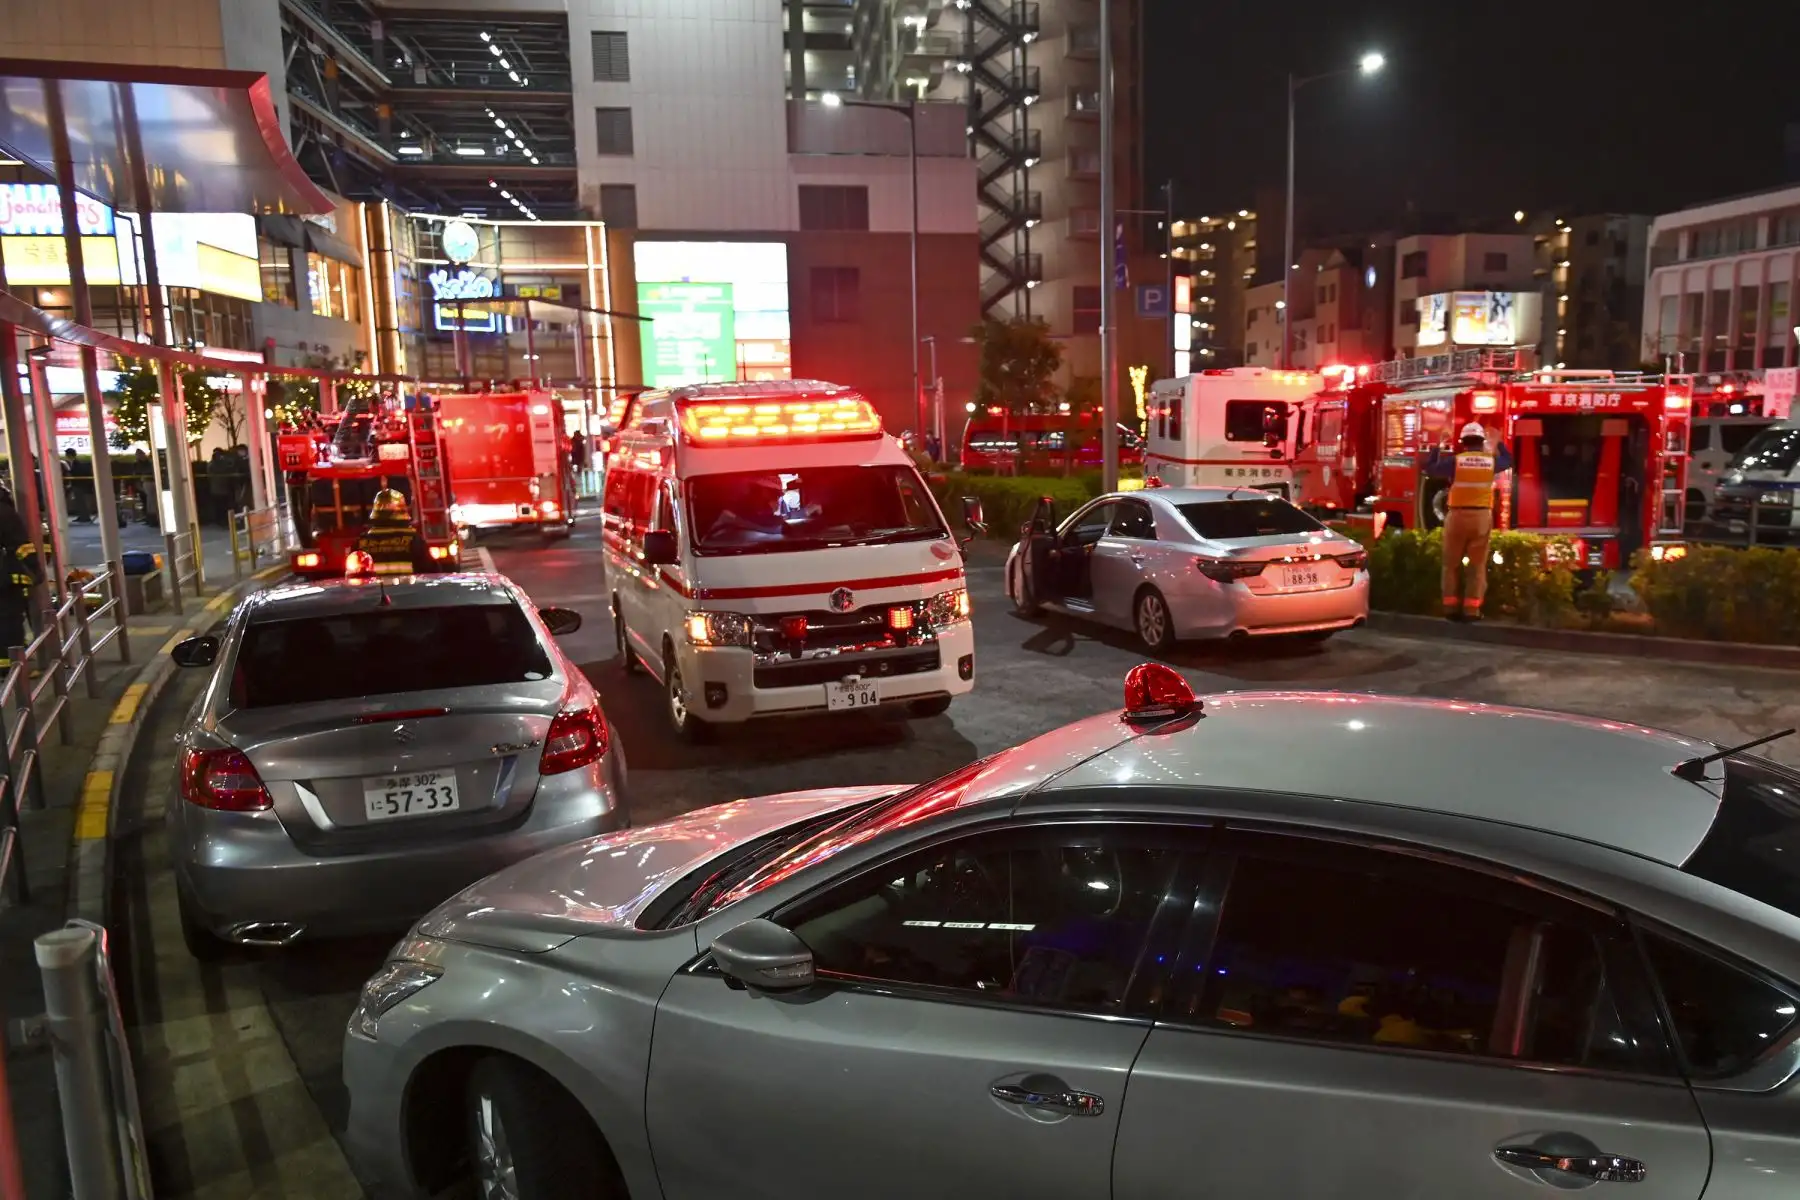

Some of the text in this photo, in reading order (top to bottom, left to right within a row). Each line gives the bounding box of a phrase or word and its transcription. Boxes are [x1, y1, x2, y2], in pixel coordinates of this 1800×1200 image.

[1144, 289, 1162, 311] P
[1549, 393, 1621, 406] 東京消防庁
[414, 774, 437, 788] 302
[371, 786, 454, 815] に 57-33
